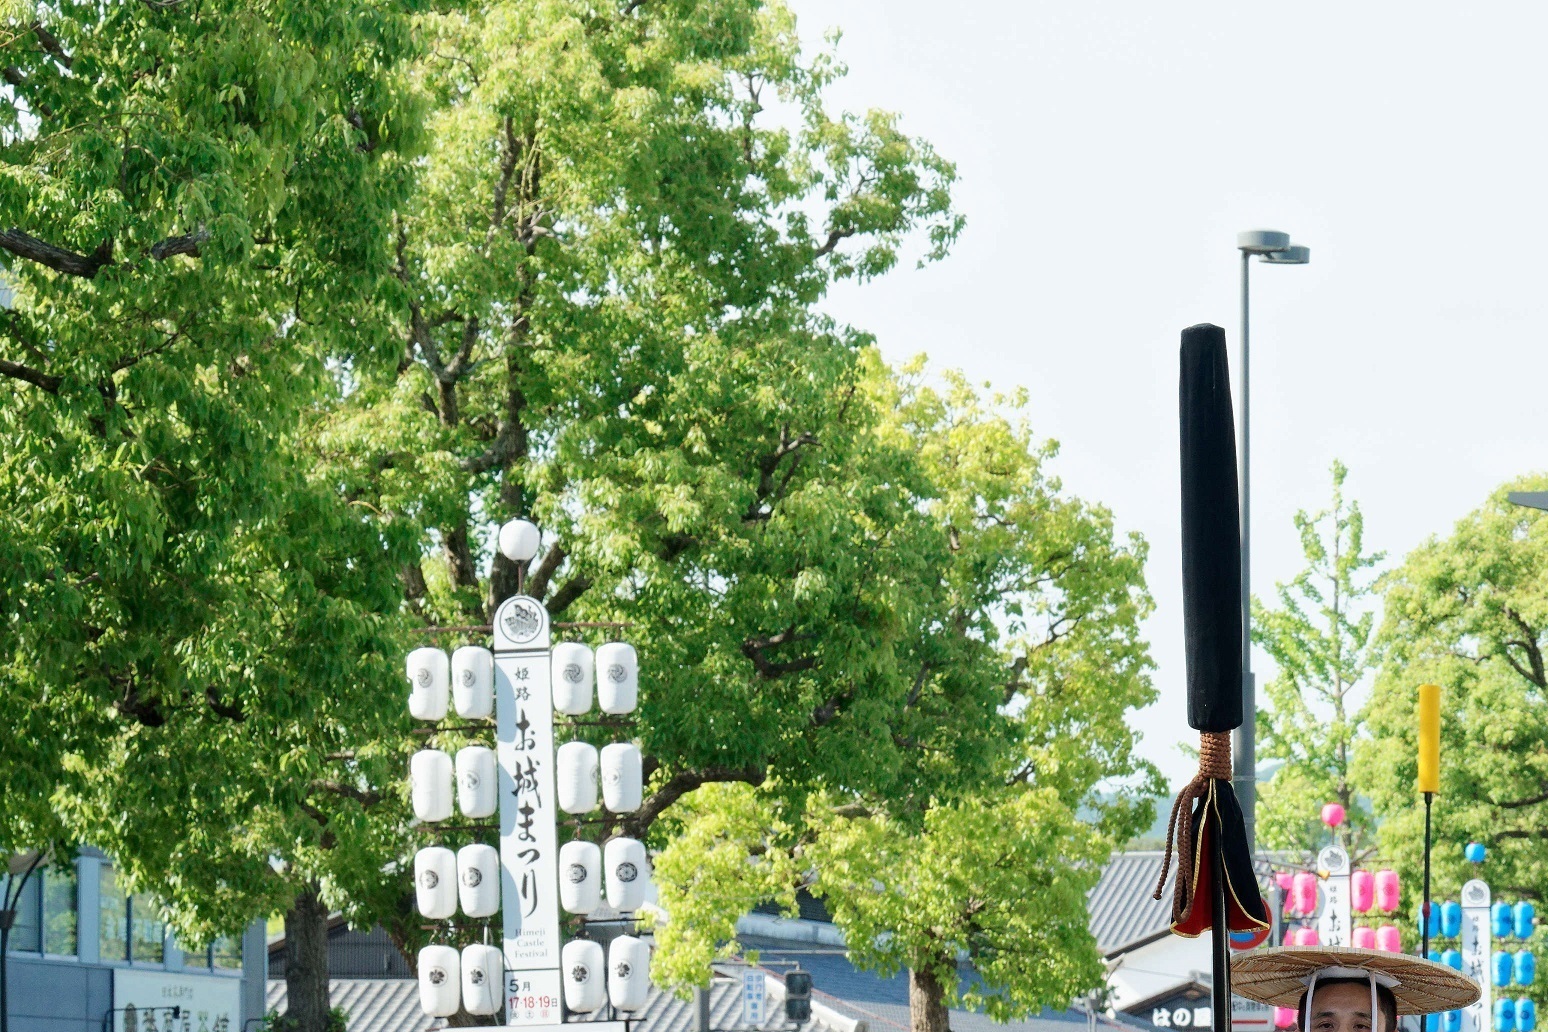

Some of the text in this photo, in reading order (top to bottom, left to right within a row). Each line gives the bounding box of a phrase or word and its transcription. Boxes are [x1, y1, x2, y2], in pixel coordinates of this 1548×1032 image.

[515, 928, 545, 937] Himeji
[517, 938, 544, 947] Castle
[515, 948, 548, 958] Festival
[509, 978, 531, 993] 5月
